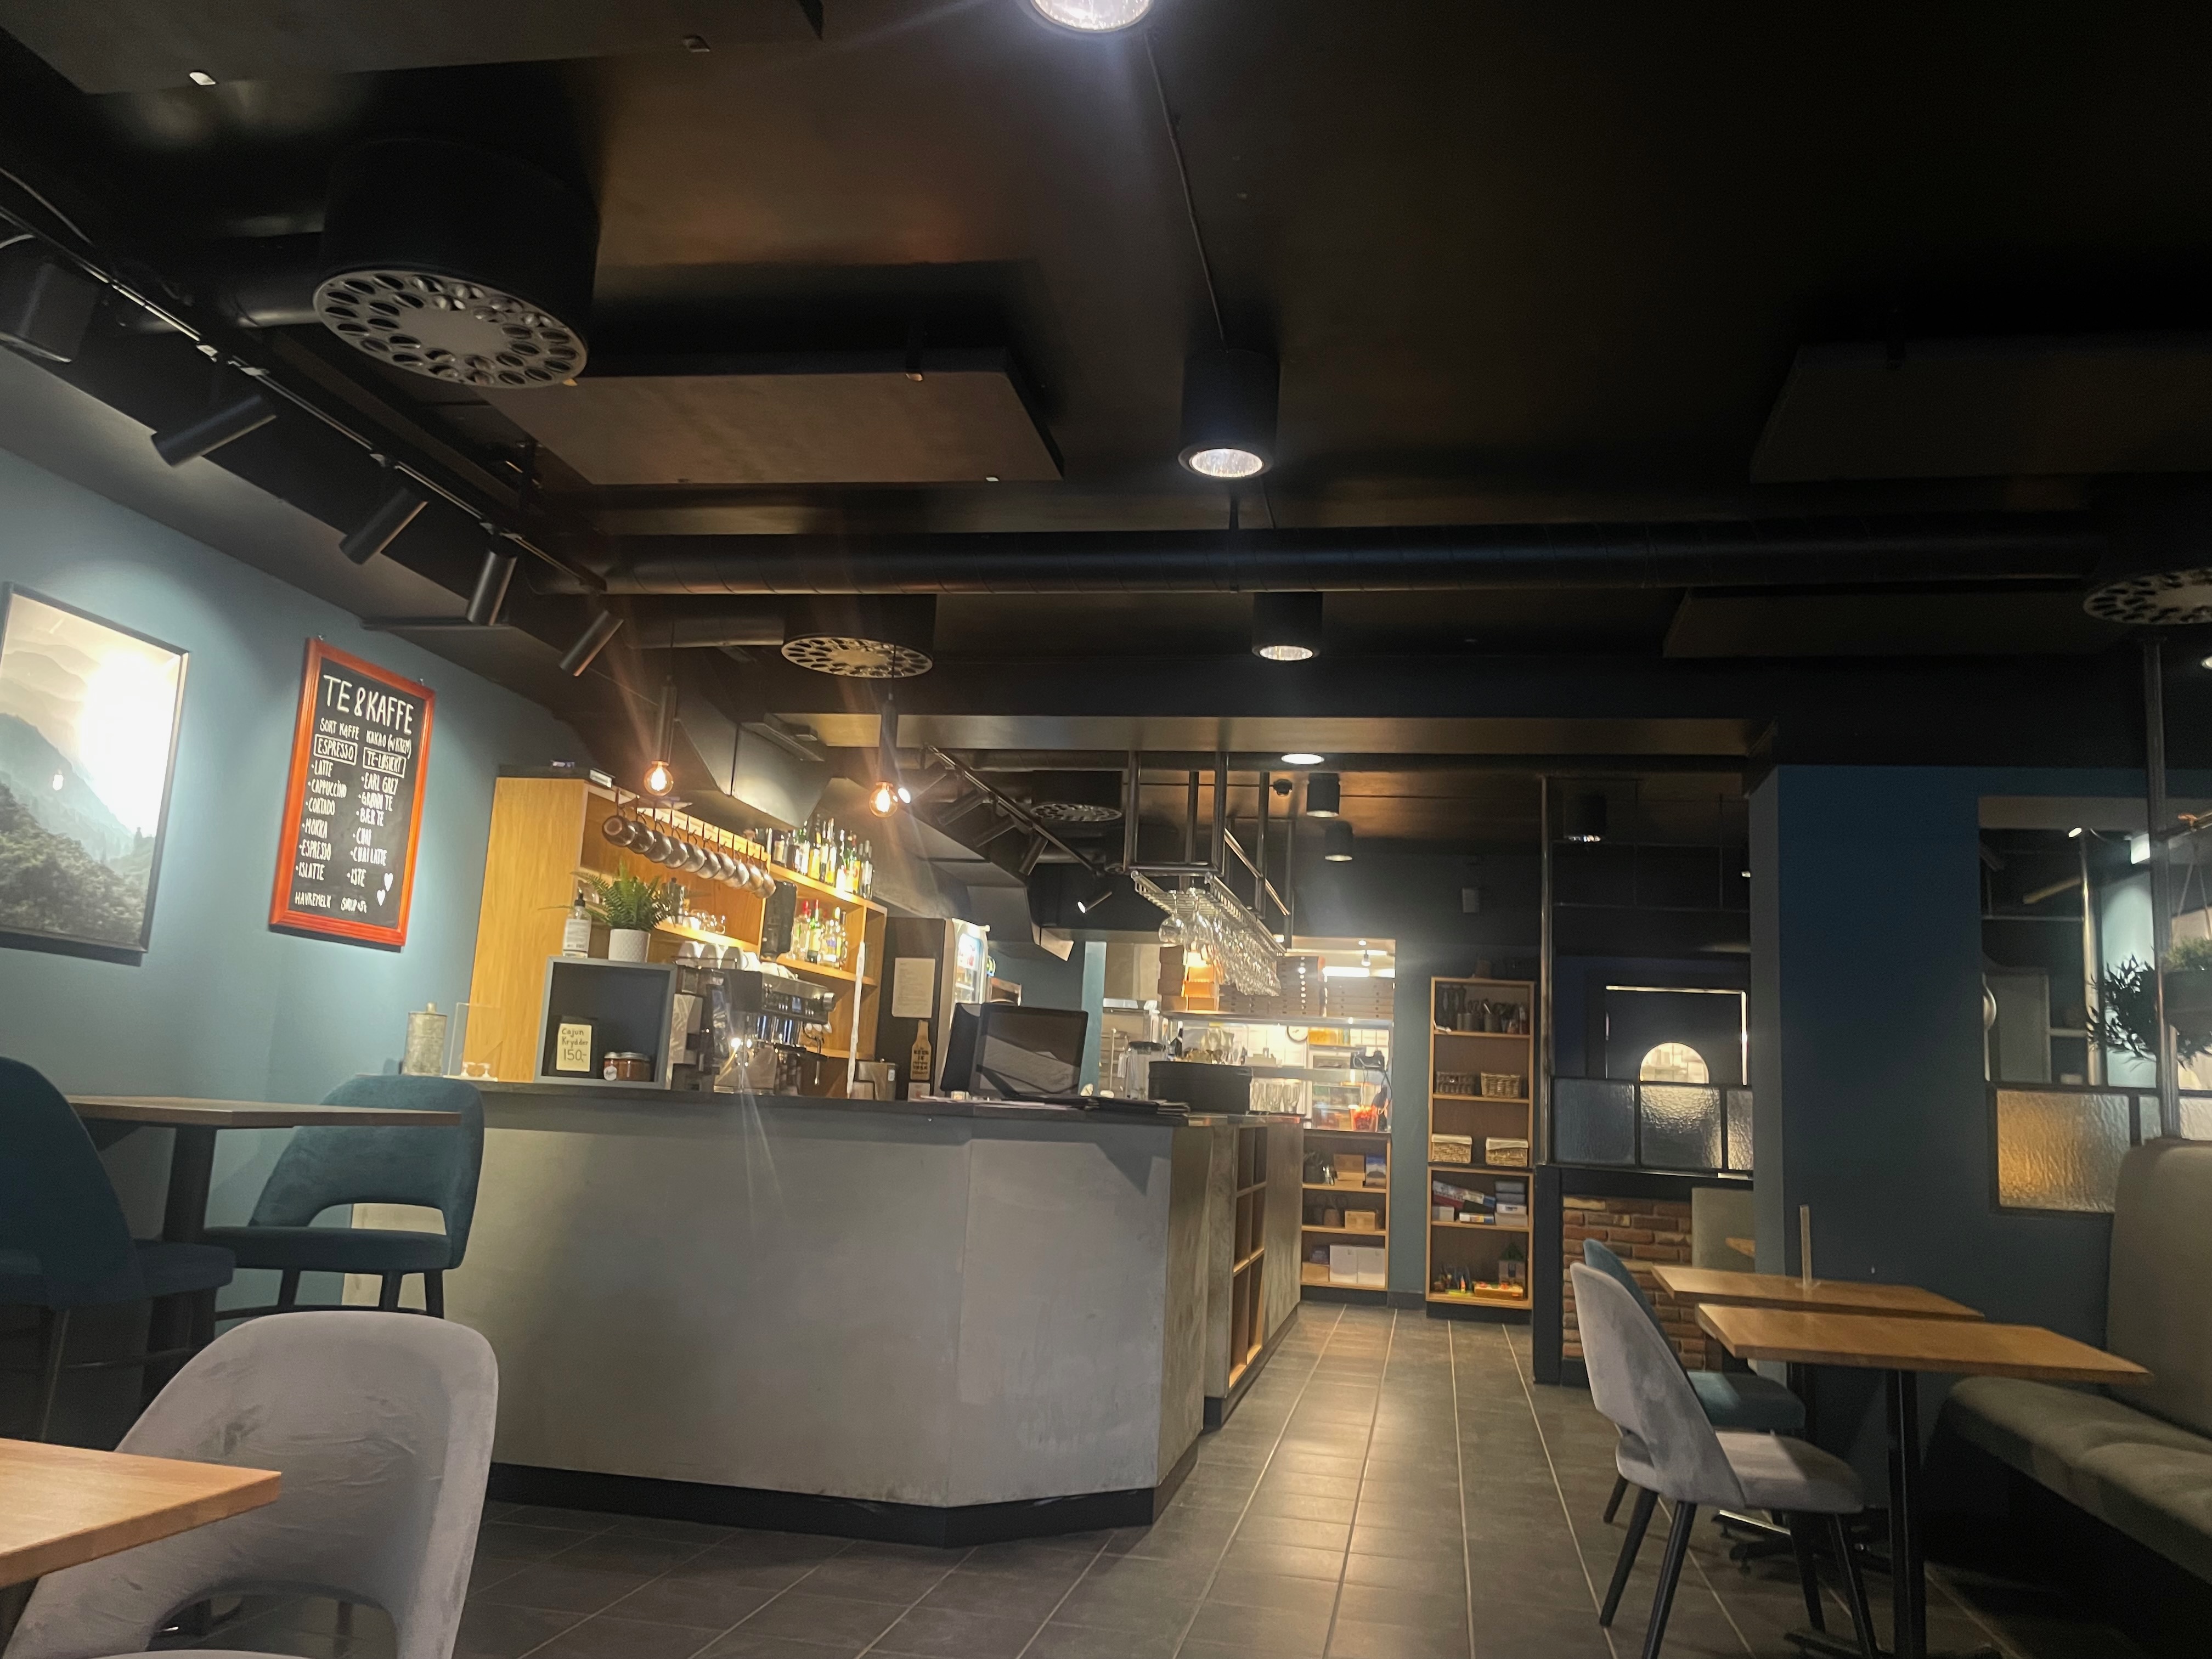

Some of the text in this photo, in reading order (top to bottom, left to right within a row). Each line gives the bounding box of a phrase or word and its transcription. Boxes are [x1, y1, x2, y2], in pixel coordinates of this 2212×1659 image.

[324, 675, 352, 713] TE
[366, 691, 414, 735] KAFFE
[319, 718, 359, 740] SORT KAFFE
[366, 730, 386, 748] KAKAO
[318, 738, 354, 760] ESPRESSO
[314, 759, 334, 777] LATTE
[364, 772, 399, 795] EARL GREY
[308, 797, 335, 816] CORTADO
[385, 794, 393, 812] TE
[376, 810, 385, 827] TE
[304, 818, 328, 839] MOKKA
[301, 839, 332, 861] ESPRESSO
[370, 848, 387, 866] LATTE
[298, 862, 325, 881] ISLATTE
[350, 868, 367, 888] ISTE
[295, 891, 332, 909] HAVREMELK
[561, 1028, 584, 1037] Cajun
[562, 1036, 589, 1048] Krydder
[564, 1048, 587, 1062] 150,-
